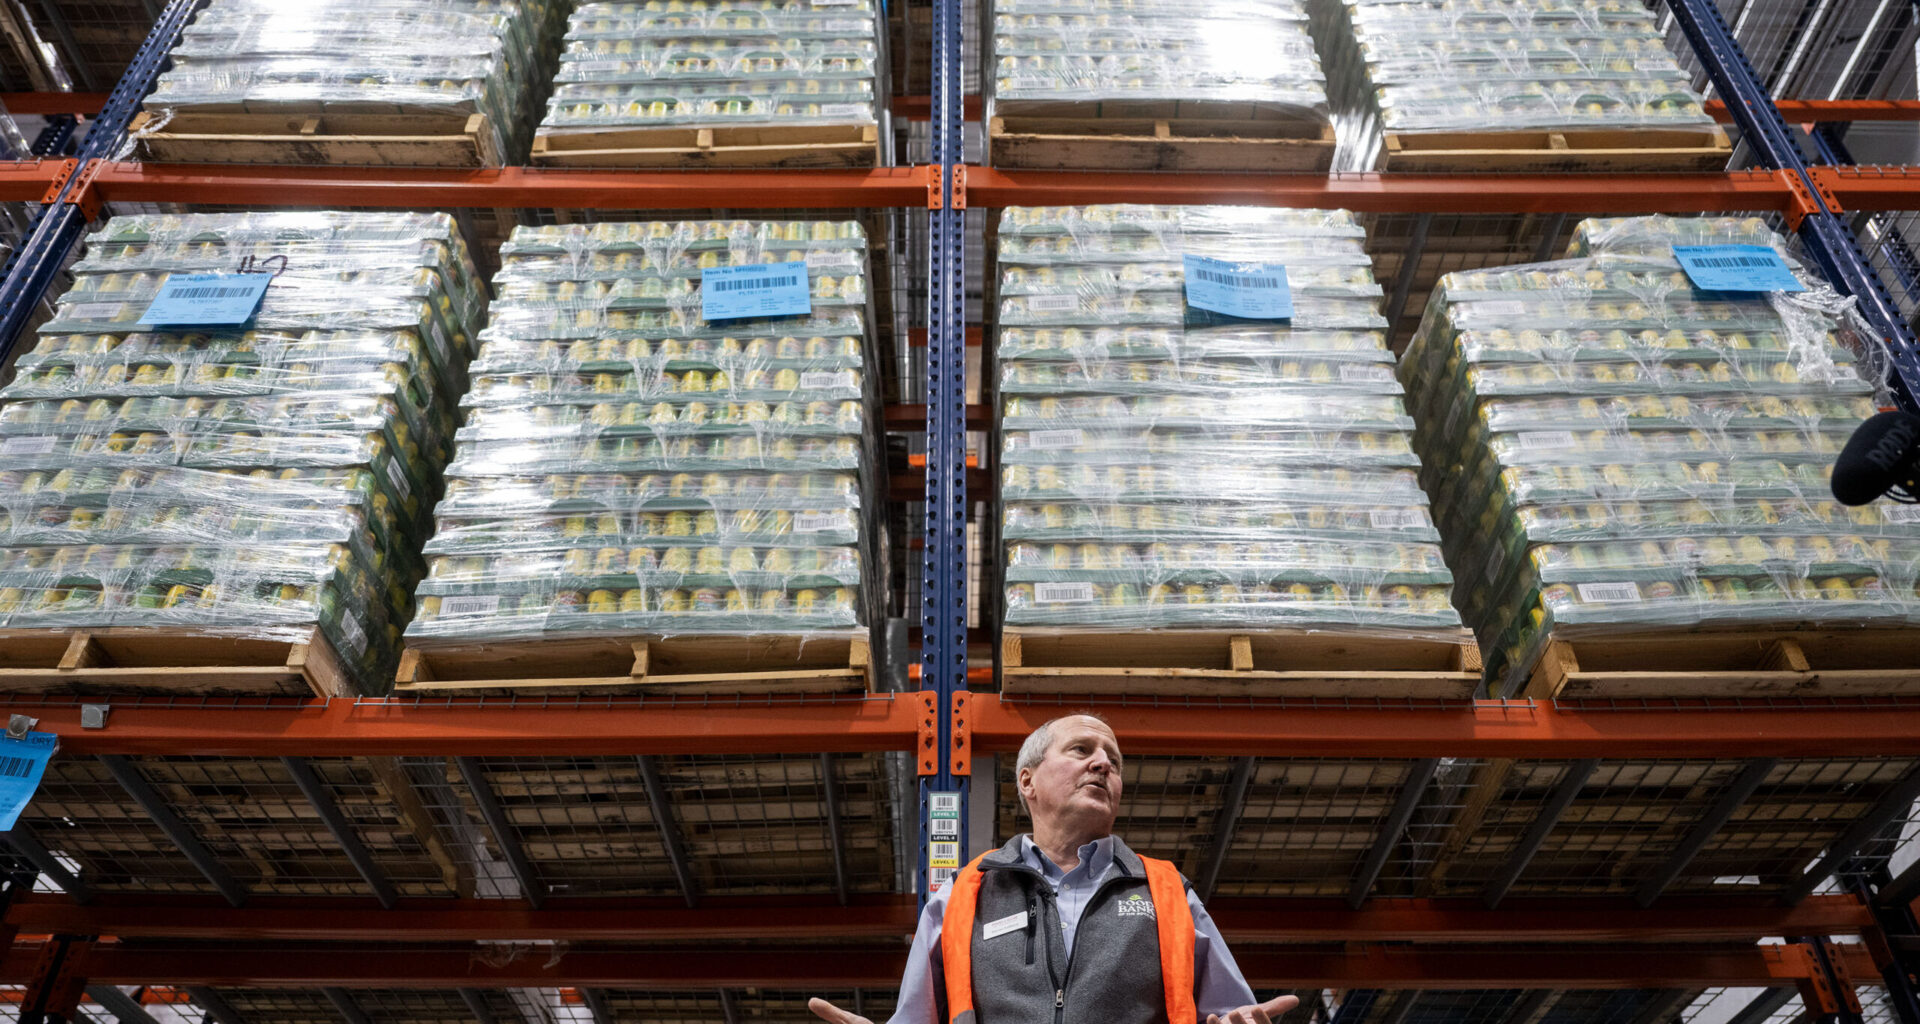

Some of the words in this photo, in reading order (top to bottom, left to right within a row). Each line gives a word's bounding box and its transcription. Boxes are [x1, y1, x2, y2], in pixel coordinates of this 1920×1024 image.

[32, 736, 51, 745] DRY
[1118, 900, 1154, 908] FOOD
[1118, 905, 1156, 916] BANK
